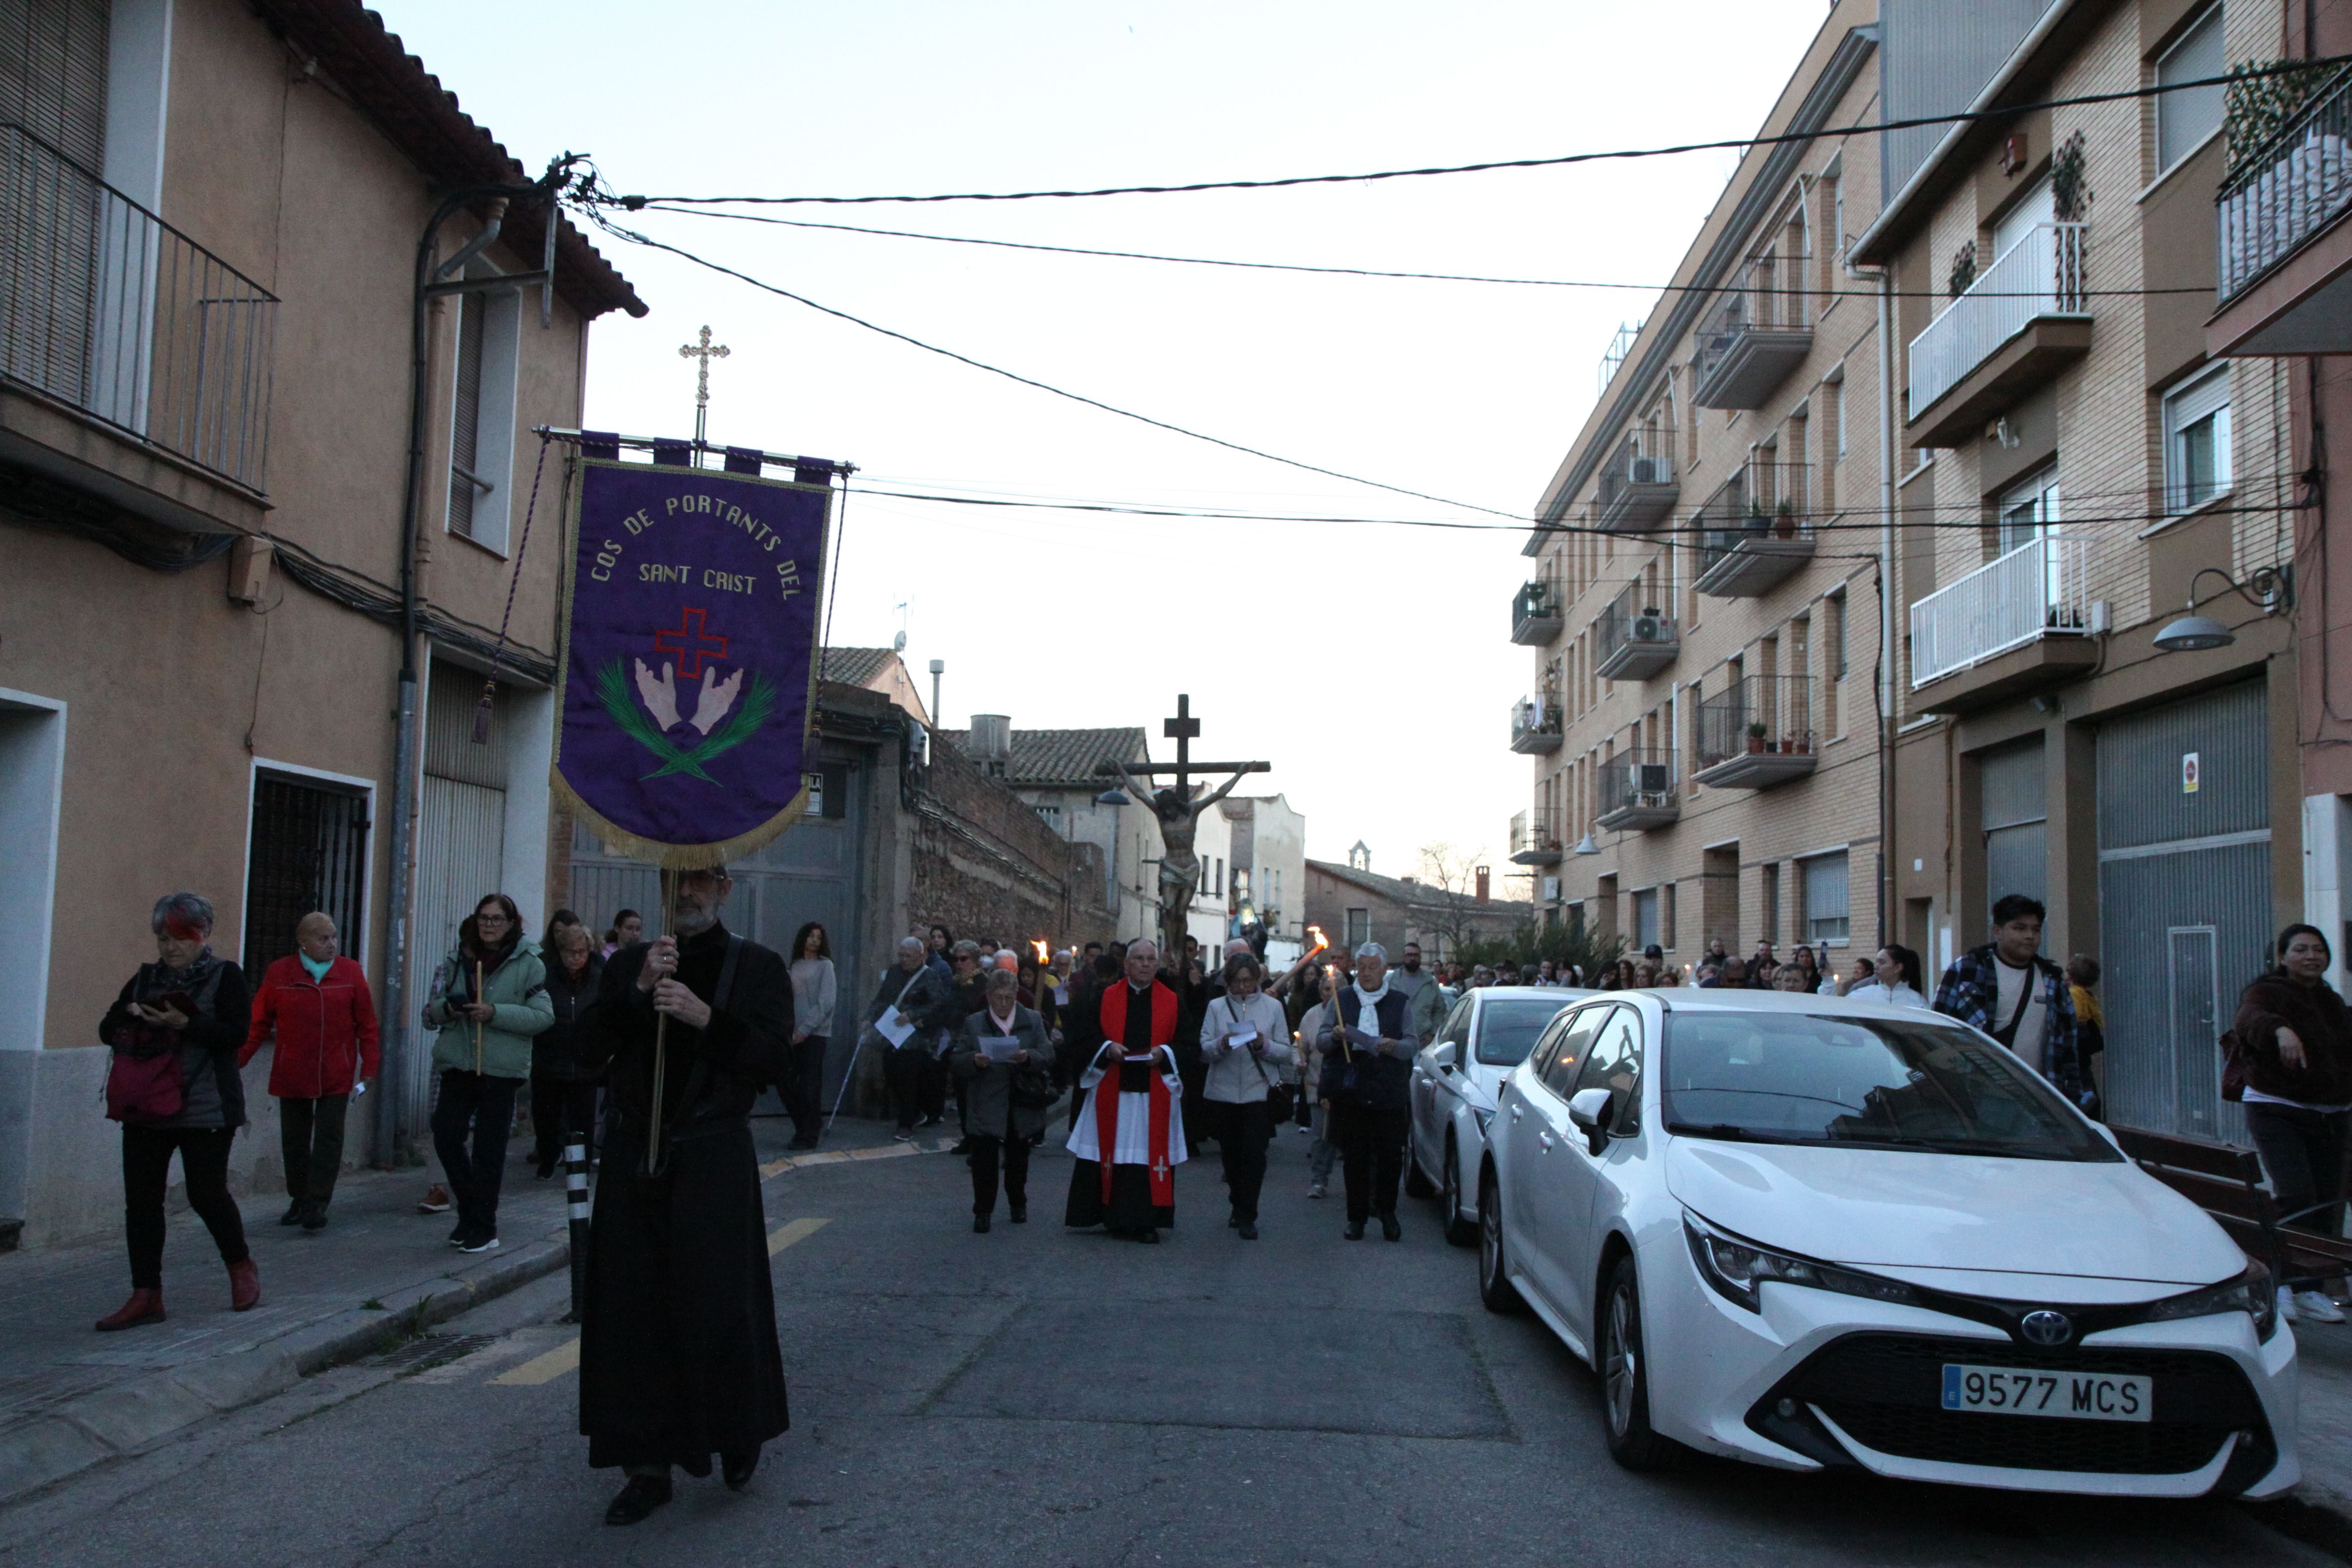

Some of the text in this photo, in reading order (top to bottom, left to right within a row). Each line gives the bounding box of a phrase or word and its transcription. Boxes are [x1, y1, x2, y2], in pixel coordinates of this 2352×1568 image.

[591, 494, 801, 600] COS DE PORTANTS DEL
[639, 563, 757, 594] SANT CRIST
[1949, 1372, 2139, 1415] E 9577 MCS
